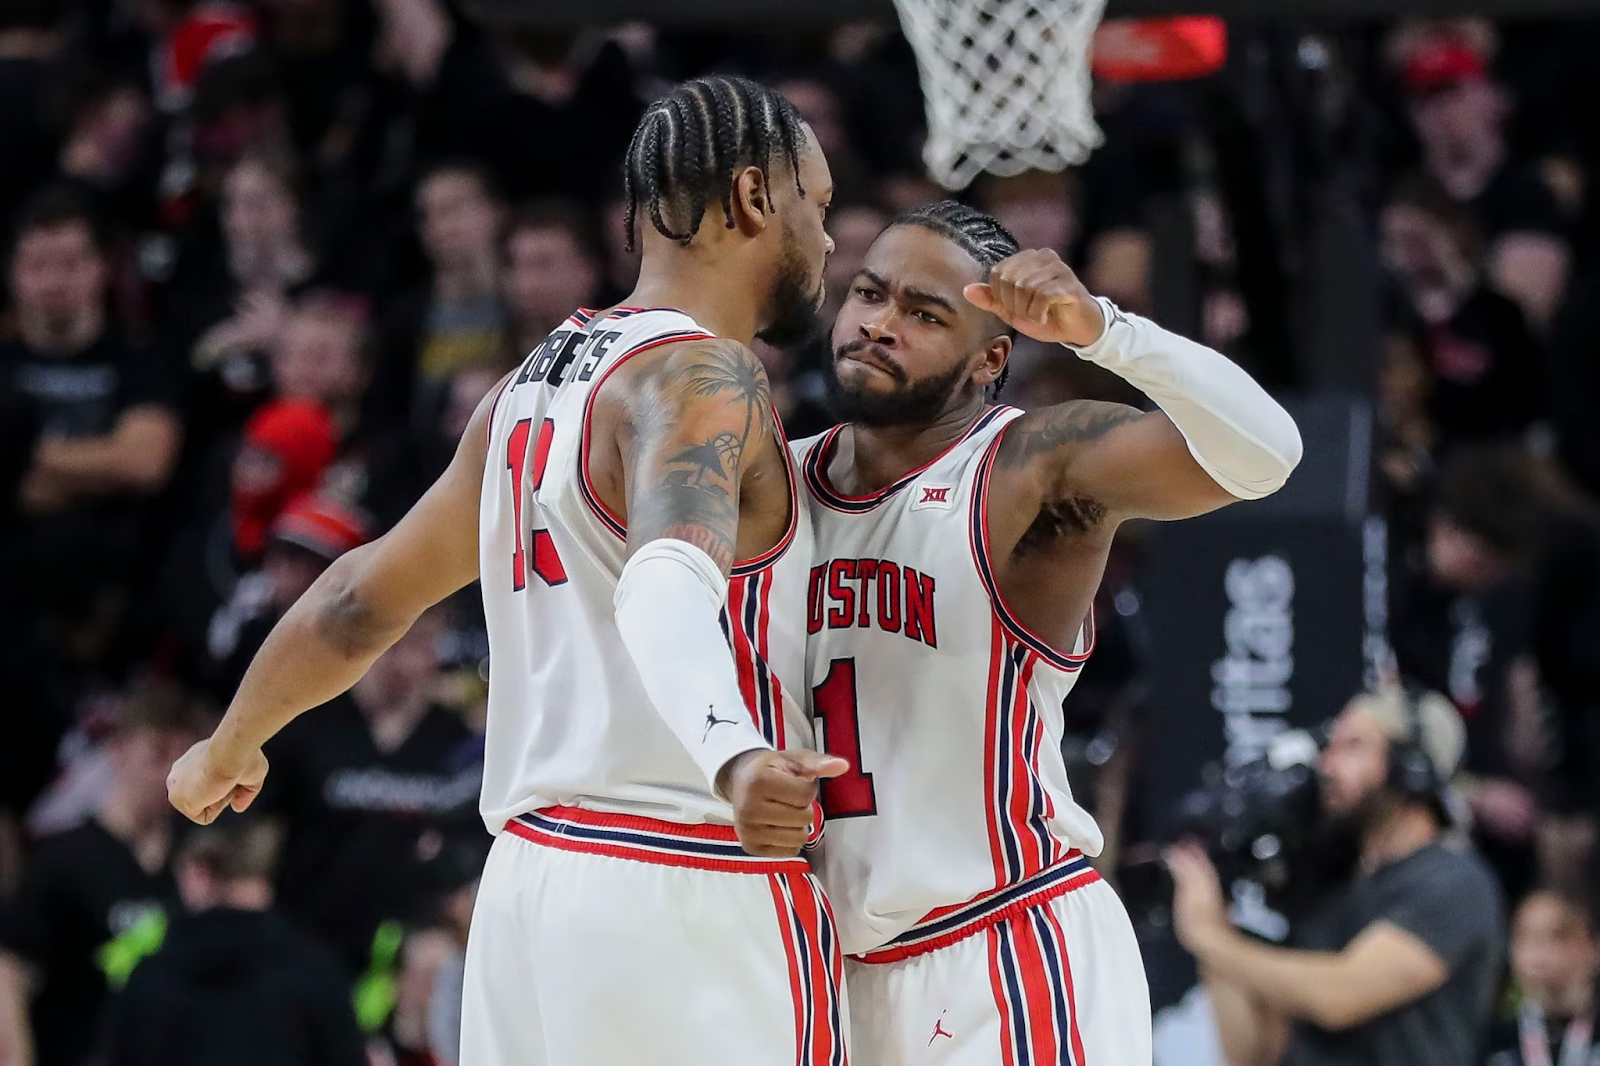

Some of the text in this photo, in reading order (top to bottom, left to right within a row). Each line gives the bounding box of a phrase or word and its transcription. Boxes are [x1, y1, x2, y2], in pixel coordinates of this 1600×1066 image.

[919, 487, 950, 503] XII
[807, 558, 937, 649] USTON
[812, 656, 878, 819] 1
